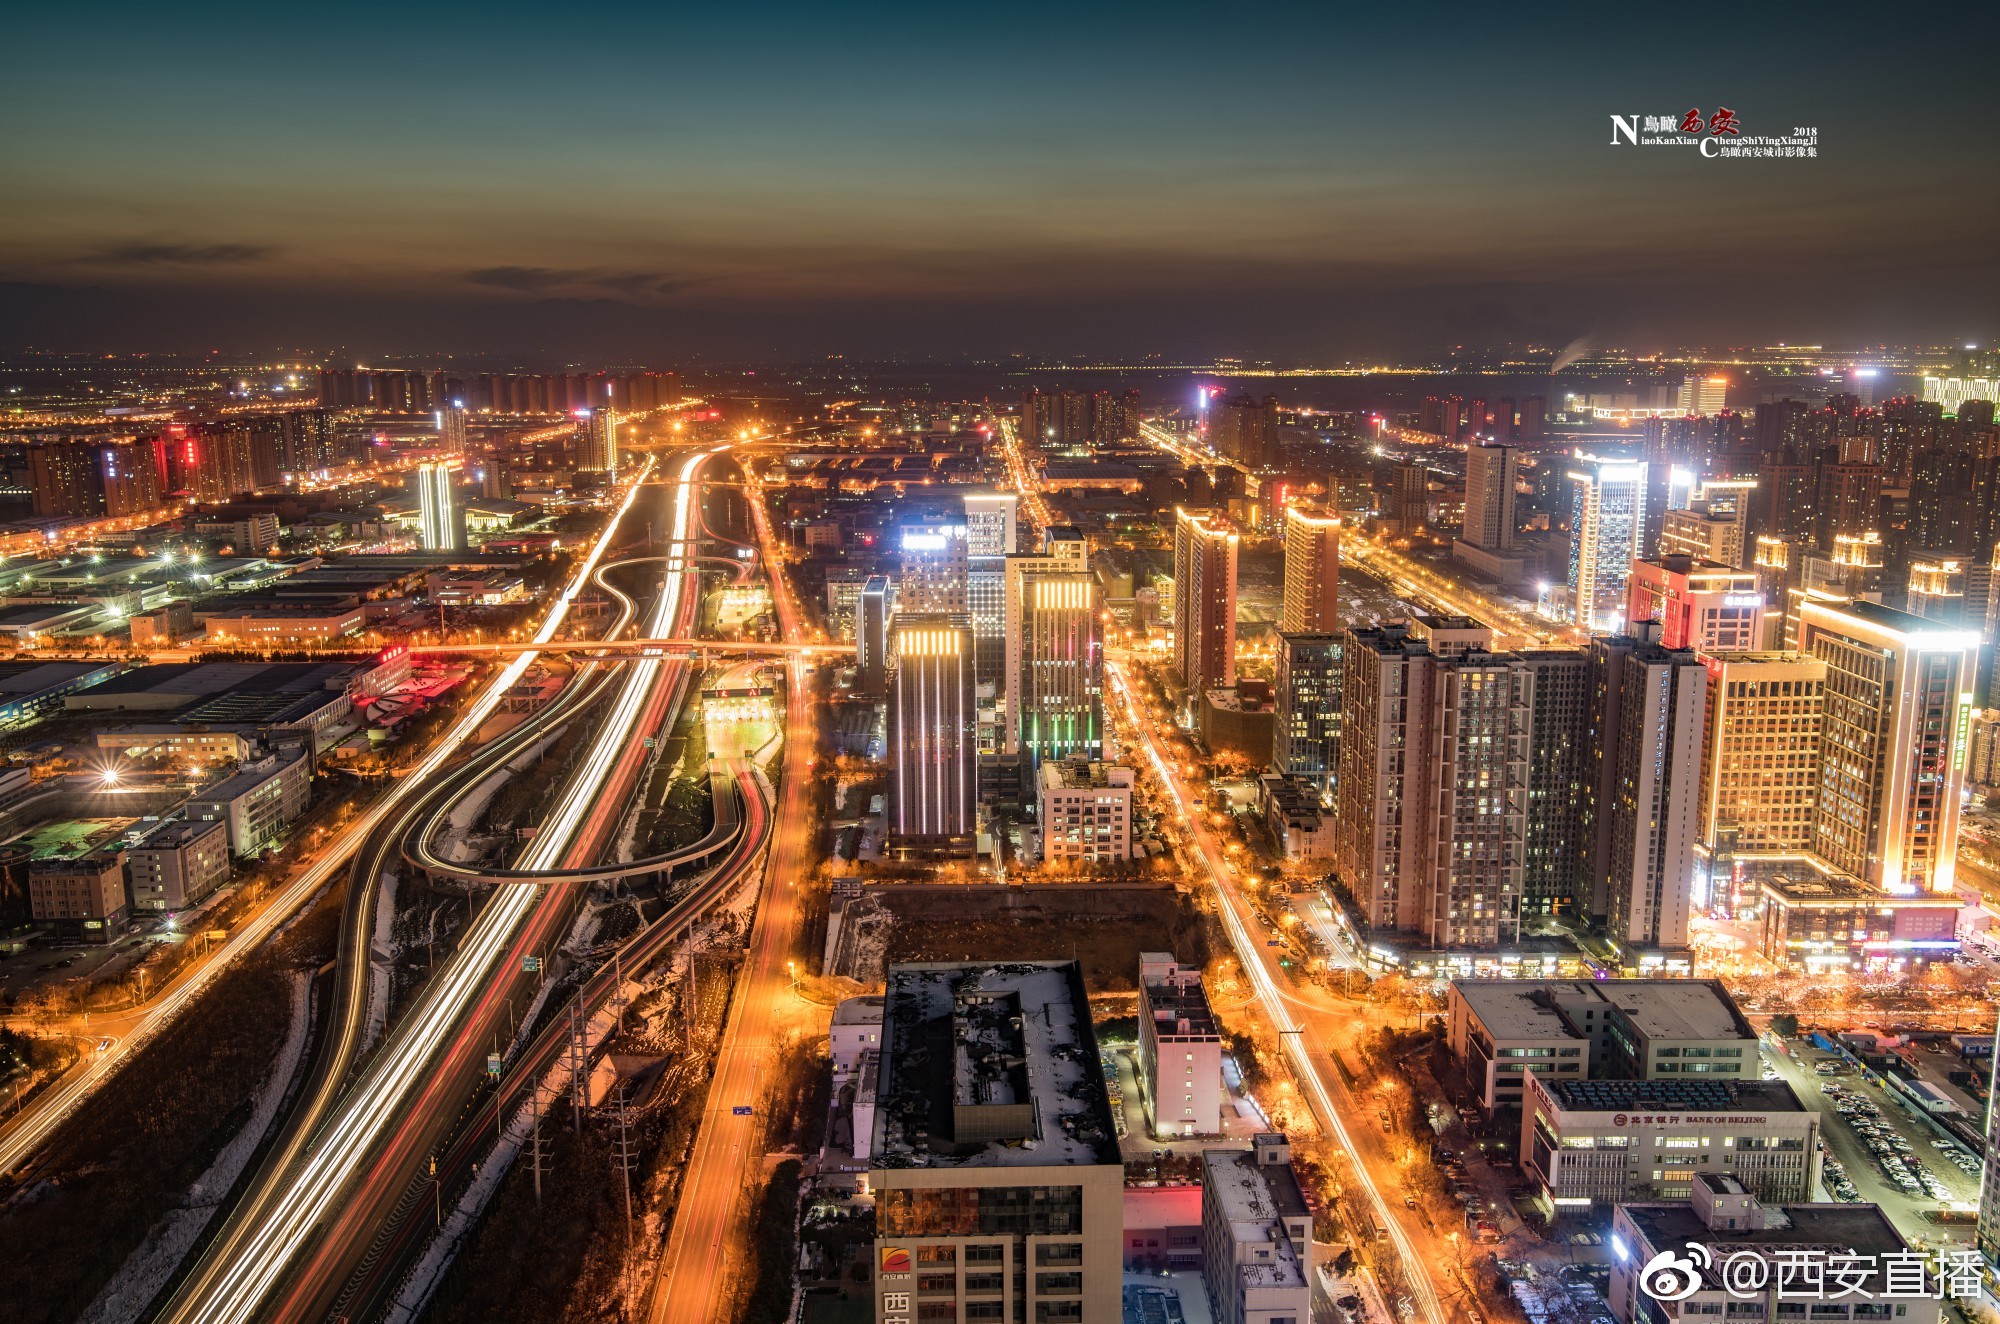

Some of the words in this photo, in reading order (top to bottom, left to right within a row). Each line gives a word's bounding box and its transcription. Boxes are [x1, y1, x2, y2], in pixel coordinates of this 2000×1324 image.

[1631, 1116, 1680, 1124] 北京银行
[1686, 1116, 1714, 1124] BANK
[1714, 1116, 1727, 1124] OF
[1728, 1116, 1767, 1124] BEIJING
